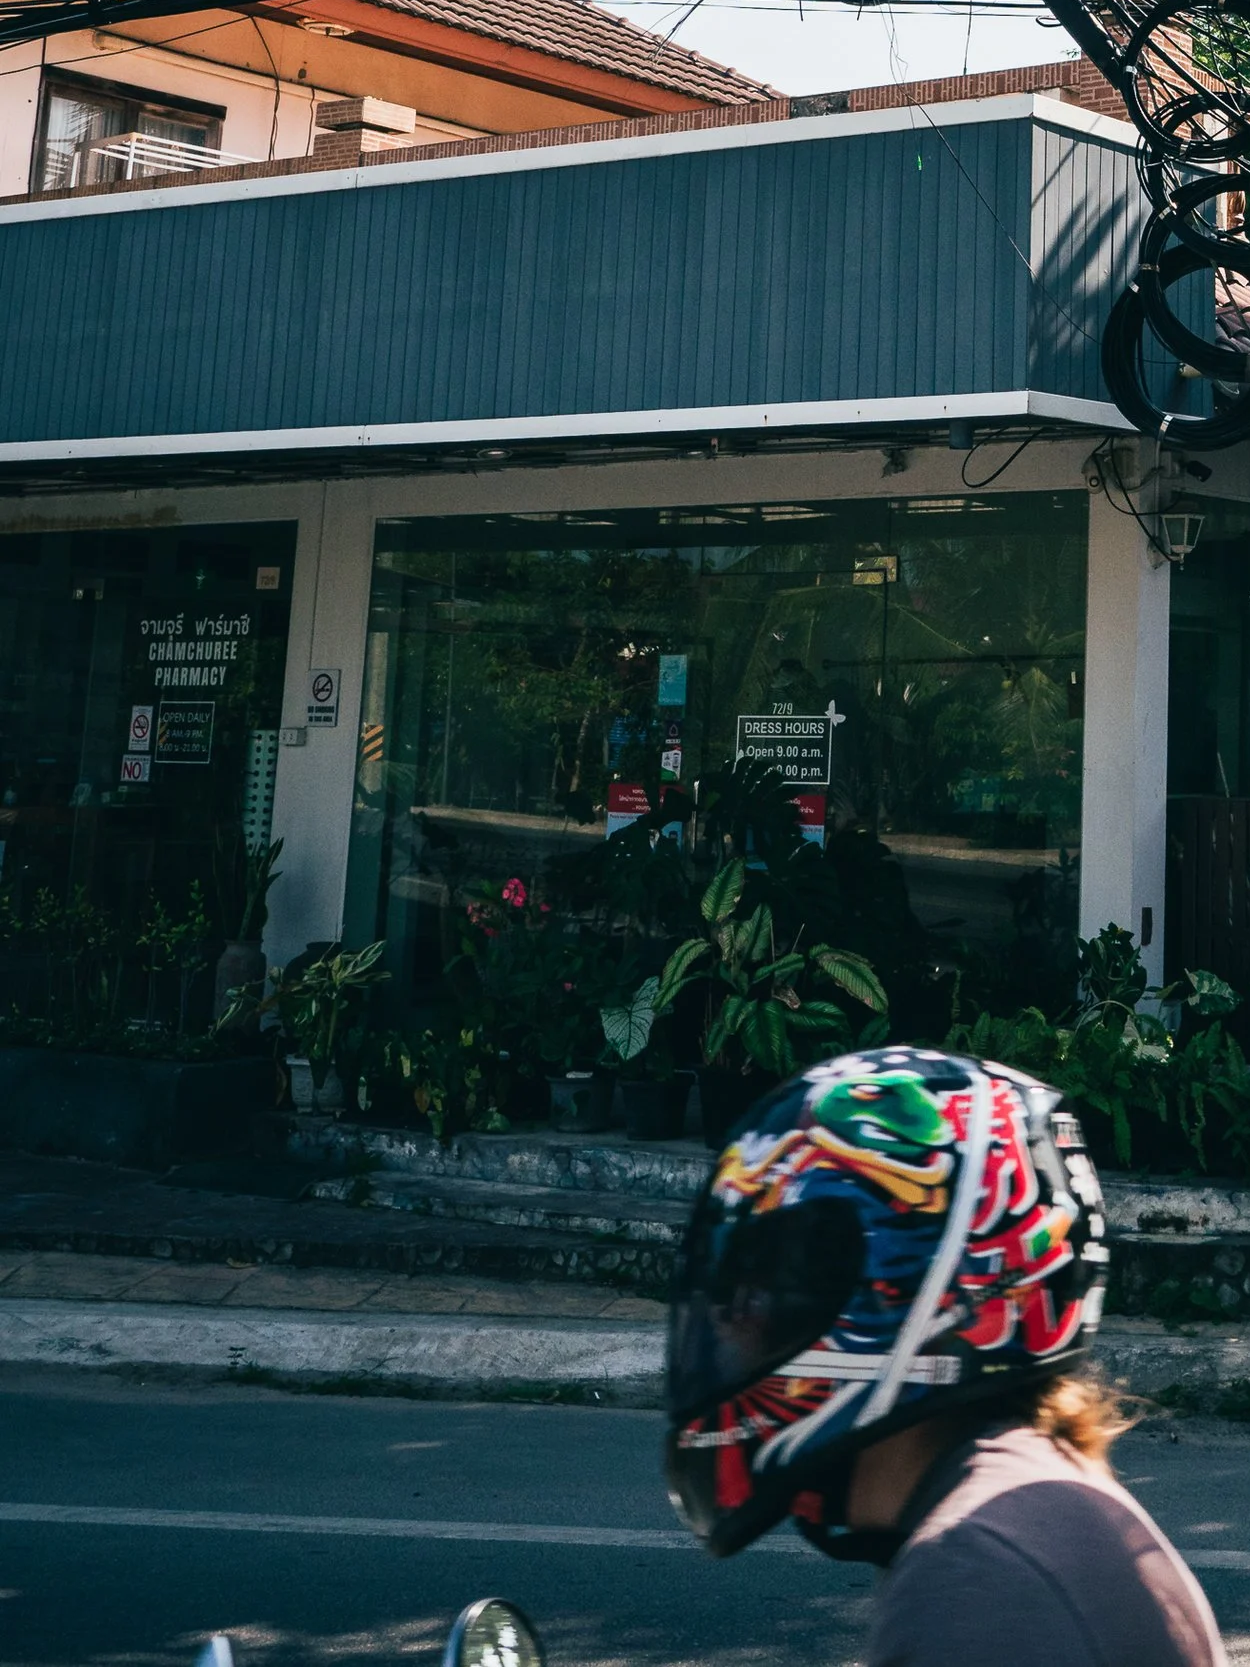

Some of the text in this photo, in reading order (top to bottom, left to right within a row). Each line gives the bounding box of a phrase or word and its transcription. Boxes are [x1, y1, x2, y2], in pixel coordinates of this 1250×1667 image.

[148, 641, 238, 661] CHAMCHUREE
[154, 666, 227, 686] PHARMACY
[772, 702, 793, 715] 72/9
[162, 713, 211, 723] OPEN DAILY
[745, 722, 825, 734] DRESS HOURS
[746, 745, 824, 760] Open 9.00 a.m.
[123, 761, 142, 779] NO
[801, 766, 823, 779] p.m.
